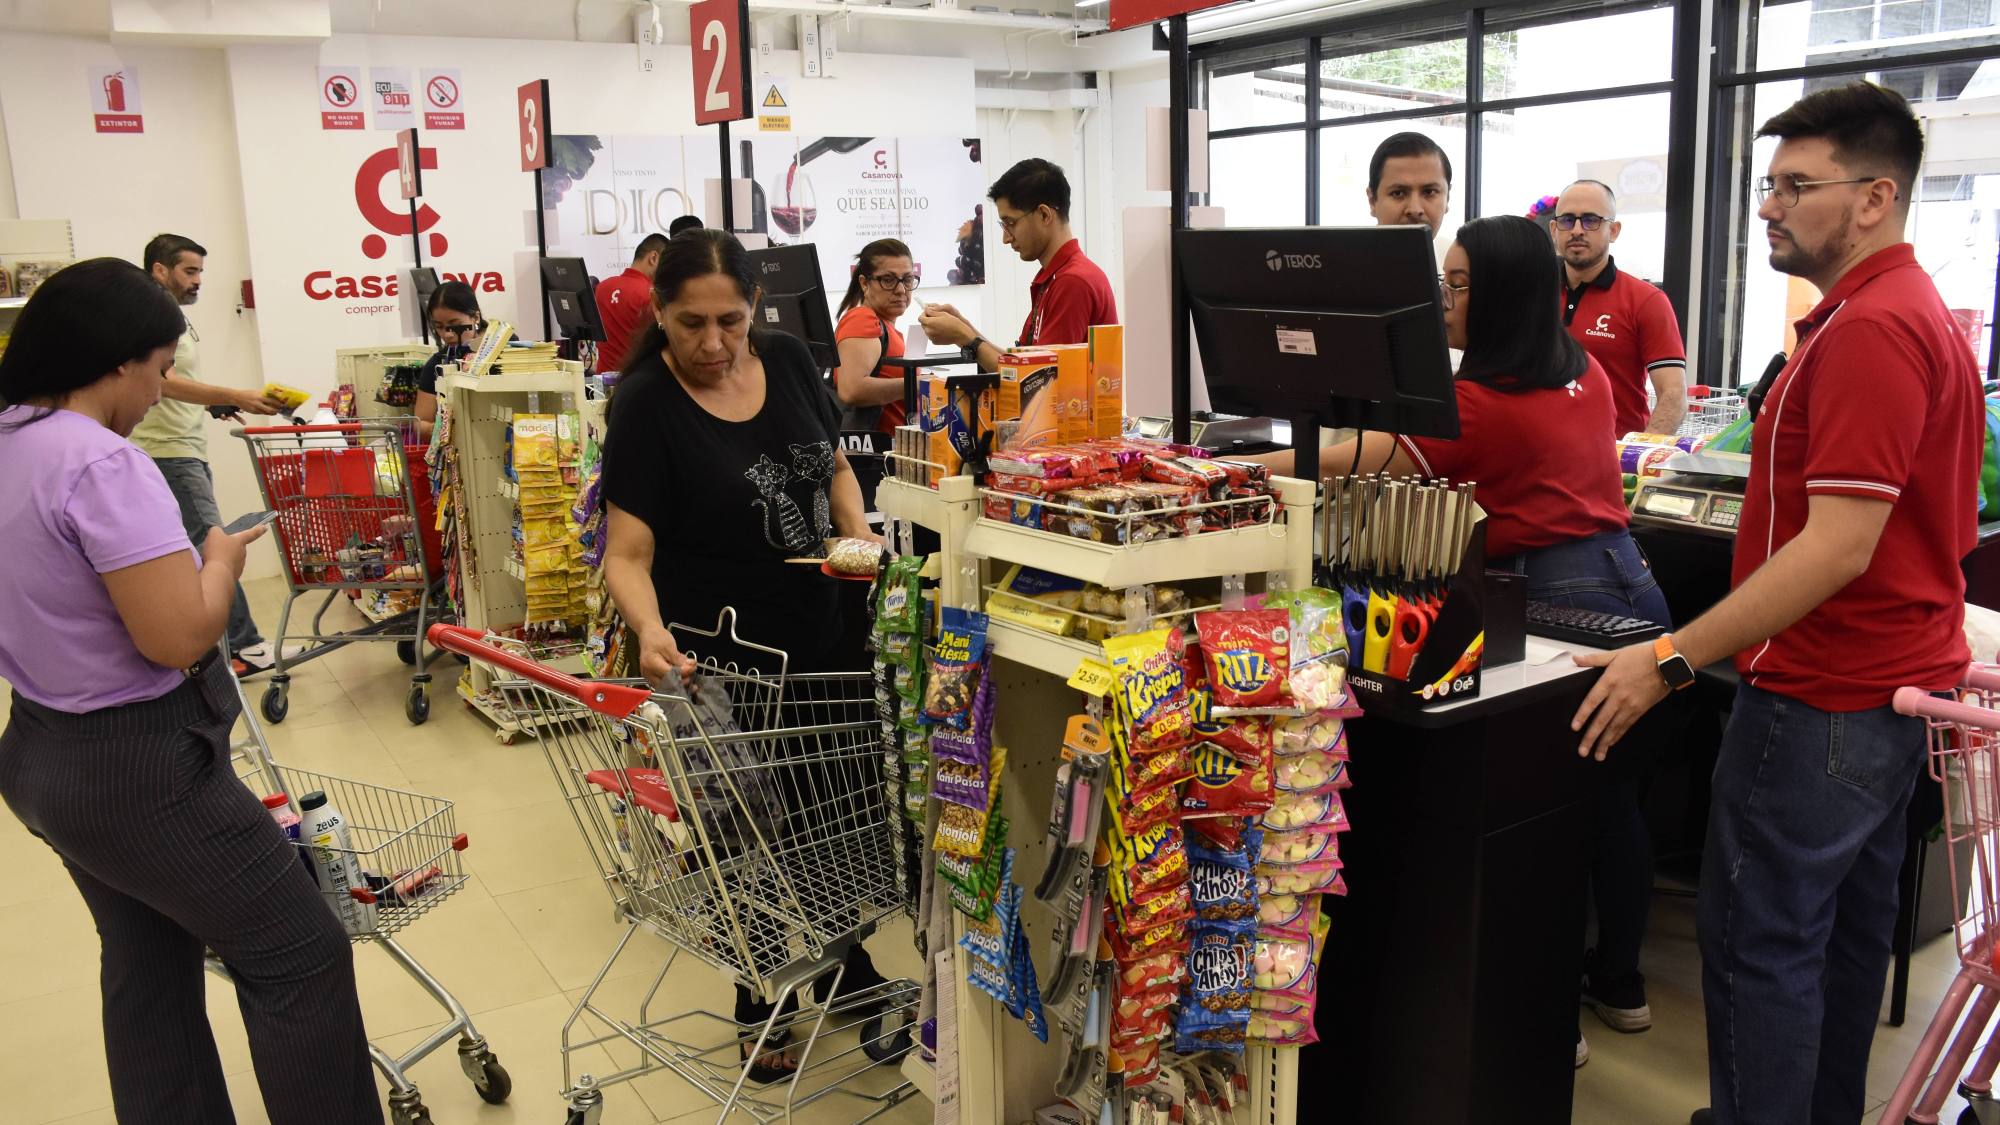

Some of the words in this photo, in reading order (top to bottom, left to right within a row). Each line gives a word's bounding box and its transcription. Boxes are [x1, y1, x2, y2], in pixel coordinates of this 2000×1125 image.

[702, 19, 730, 112] 2
[376, 81, 391, 92] ECU
[384, 94, 409, 104] 911
[523, 98, 538, 162] 3
[401, 142, 411, 193] 4
[578, 187, 694, 236] DIO
[837, 196, 867, 213] QUE
[870, 196, 897, 210] SEA
[903, 196, 929, 210] DIO
[1283, 254, 1322, 269] TEROS
[345, 304, 395, 316] comprar
[1585, 328, 1616, 339] Casanova
[1216, 636, 1254, 649] mini
[935, 643, 971, 662] Fiesta
[1211, 652, 1272, 686] RITZ
[1347, 674, 1383, 694] LIGHTER
[954, 773, 985, 789] Pasas
[316, 815, 340, 833] zeus
[936, 822, 979, 844] Ajonjolí
[1203, 934, 1229, 946] Mini
[1192, 946, 1236, 974] Chips
